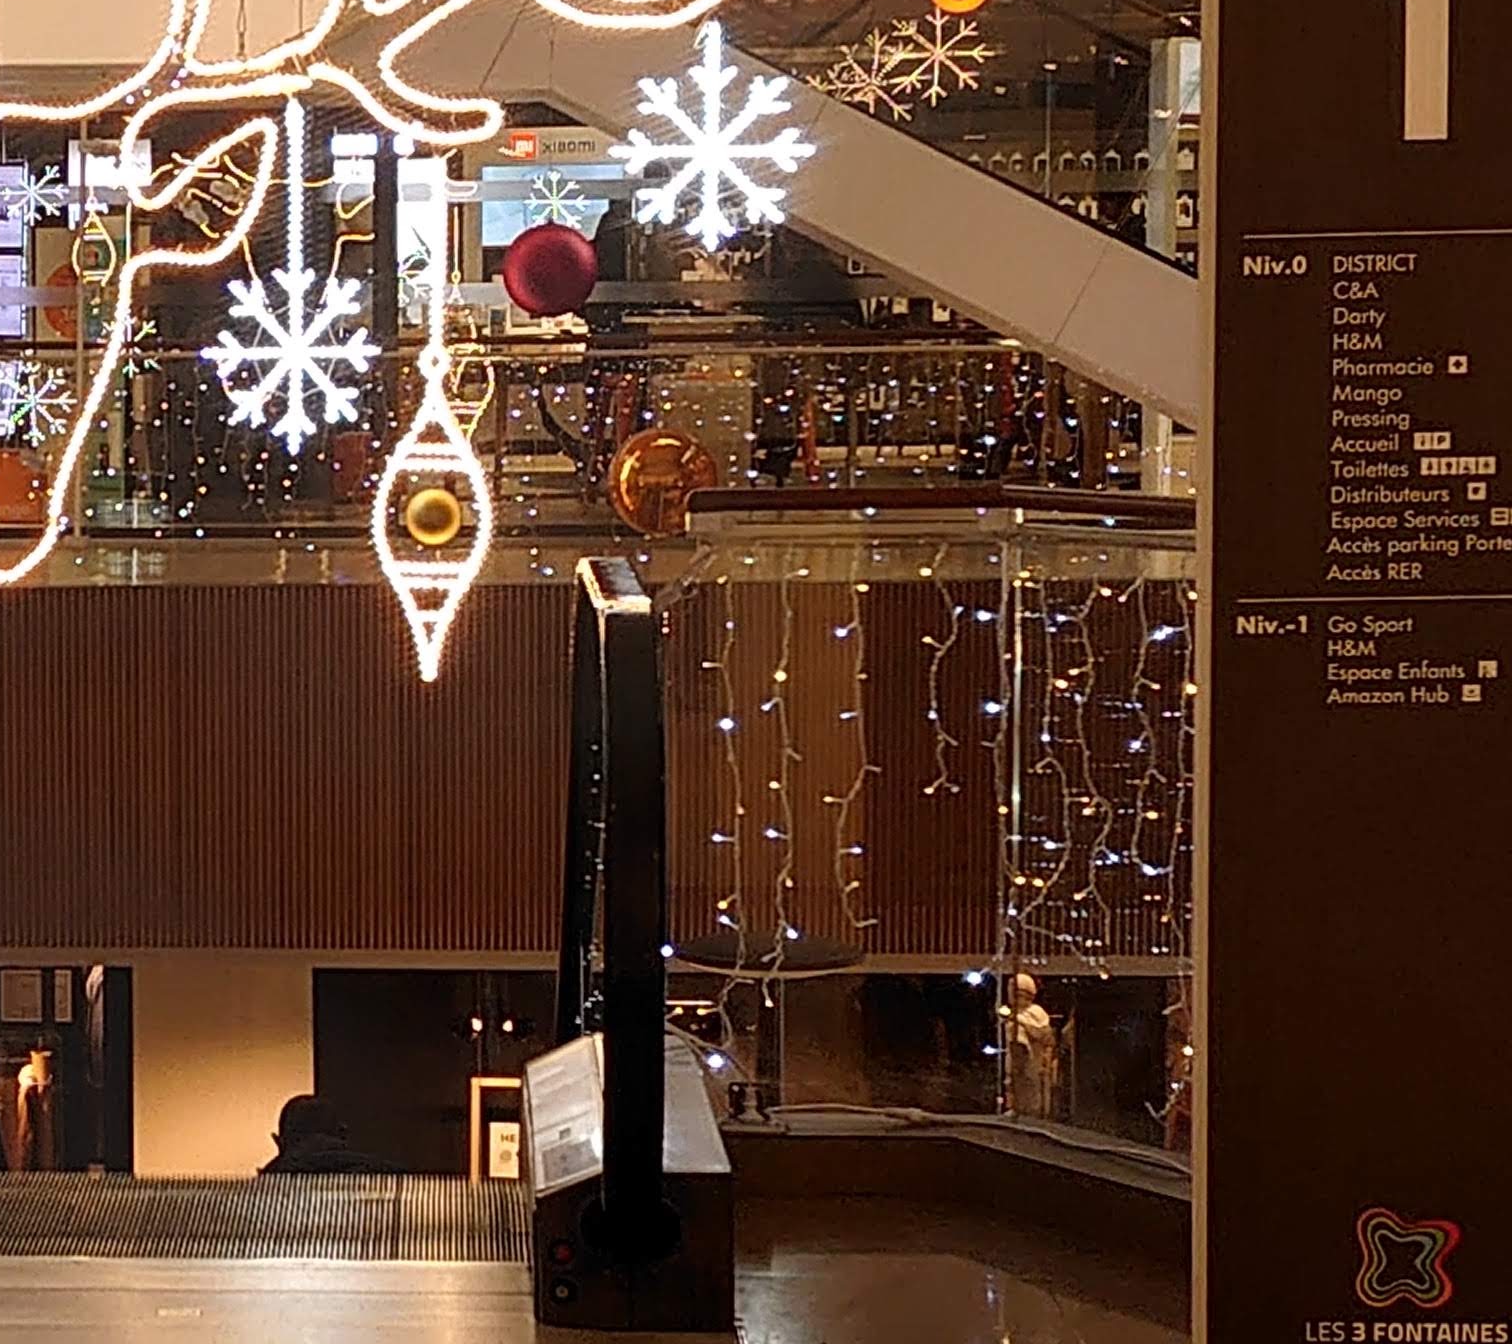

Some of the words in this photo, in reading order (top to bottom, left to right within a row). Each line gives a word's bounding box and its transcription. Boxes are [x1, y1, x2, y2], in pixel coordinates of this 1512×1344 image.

[1243, 255, 1307, 276] Niv.0
[1333, 253, 1418, 274] DISTRICT
[1332, 280, 1380, 300] C&A
[1333, 307, 1386, 329] Darty
[1333, 332, 1383, 351] H&M
[1332, 356, 1434, 377] Pharmacie
[1332, 384, 1403, 406] Mango
[1332, 408, 1411, 431] Pressing
[1330, 433, 1399, 453] Accueil
[1330, 459, 1409, 479] Toilettes
[1331, 484, 1450, 504] Distributeurs
[1331, 511, 1398, 533] Espace
[1403, 509, 1481, 528] Services
[1325, 536, 1382, 554] Accès
[1387, 532, 1460, 557] parking
[1465, 533, 1512, 551] Porte
[1325, 564, 1382, 581] Accès
[1387, 562, 1422, 580] RER
[1236, 615, 1308, 635] Niv.-1
[1327, 615, 1358, 634] Go
[1362, 615, 1413, 637] Sport
[1327, 639, 1376, 657] H&M
[1327, 662, 1393, 685] Espace
[1398, 659, 1466, 680] Enfants
[1326, 687, 1405, 704] Amazon
[1411, 684, 1450, 703] Hub
[1305, 1321, 1346, 1343] LES
[1351, 1322, 1366, 1343] 3
[1373, 1322, 1509, 1344] FONTAINES
